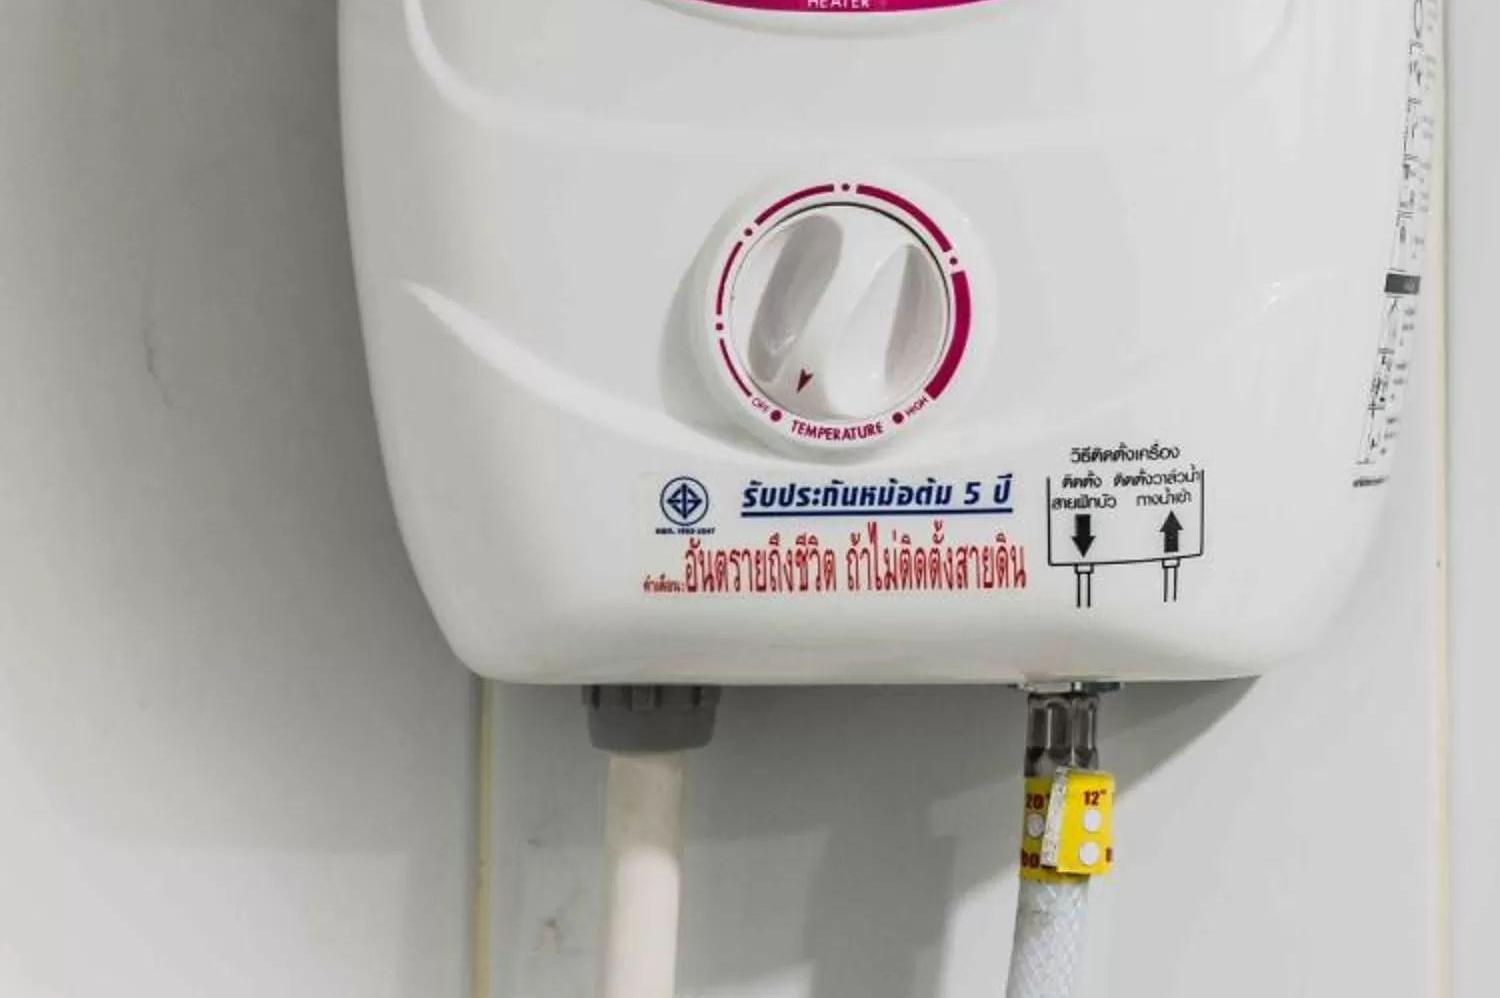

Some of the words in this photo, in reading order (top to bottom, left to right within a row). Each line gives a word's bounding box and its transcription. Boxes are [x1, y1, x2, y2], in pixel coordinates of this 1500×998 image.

[791, 419, 885, 441] TEMPERATURE
[741, 477, 953, 508] รับประกันหม้อต้ม
[963, 481, 981, 505] 5
[994, 473, 1014, 505] ปี
